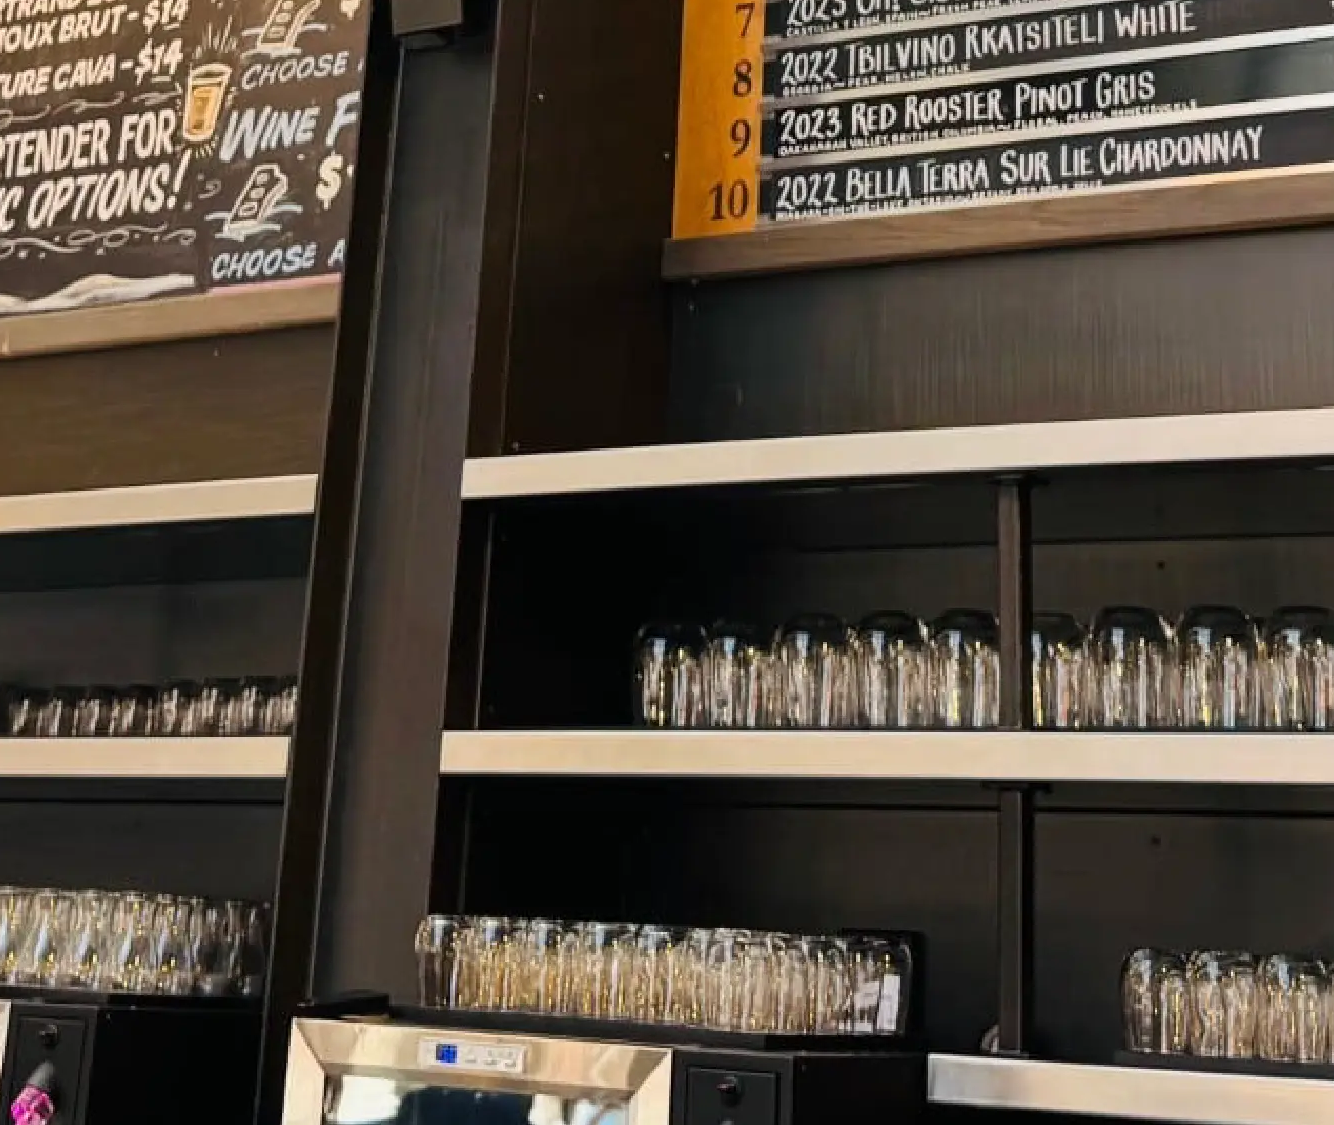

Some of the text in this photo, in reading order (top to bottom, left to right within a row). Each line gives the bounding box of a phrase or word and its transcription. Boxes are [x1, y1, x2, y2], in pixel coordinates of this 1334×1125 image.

[58, 3, 123, 46] BRUT
[735, 3, 755, 38] 7
[781, 46, 838, 85] 2022
[849, 33, 955, 75] TBILVINO
[966, 9, 1104, 60] RKATSITELI
[53, 53, 117, 93] CAVA
[241, 51, 349, 90] CHOOSE
[733, 59, 752, 97] 8
[780, 107, 842, 144] 2023
[851, 102, 897, 135] RED
[905, 87, 1003, 131] ROOSTER
[1015, 77, 1088, 119] PINOT
[1096, 71, 1155, 109] GRIS
[117, 109, 178, 162] FOR
[219, 105, 320, 163] WINE
[730, 119, 751, 157] 9
[776, 172, 838, 210] 2022
[846, 166, 911, 201] BELLA
[918, 158, 989, 194] TERRA
[1001, 149, 1050, 185] SUR
[1099, 126, 1263, 174] CHARDONNAY
[27, 149, 192, 230] OPTIONS!
[708, 180, 750, 221] 10
[212, 245, 317, 280] CHOOSE
